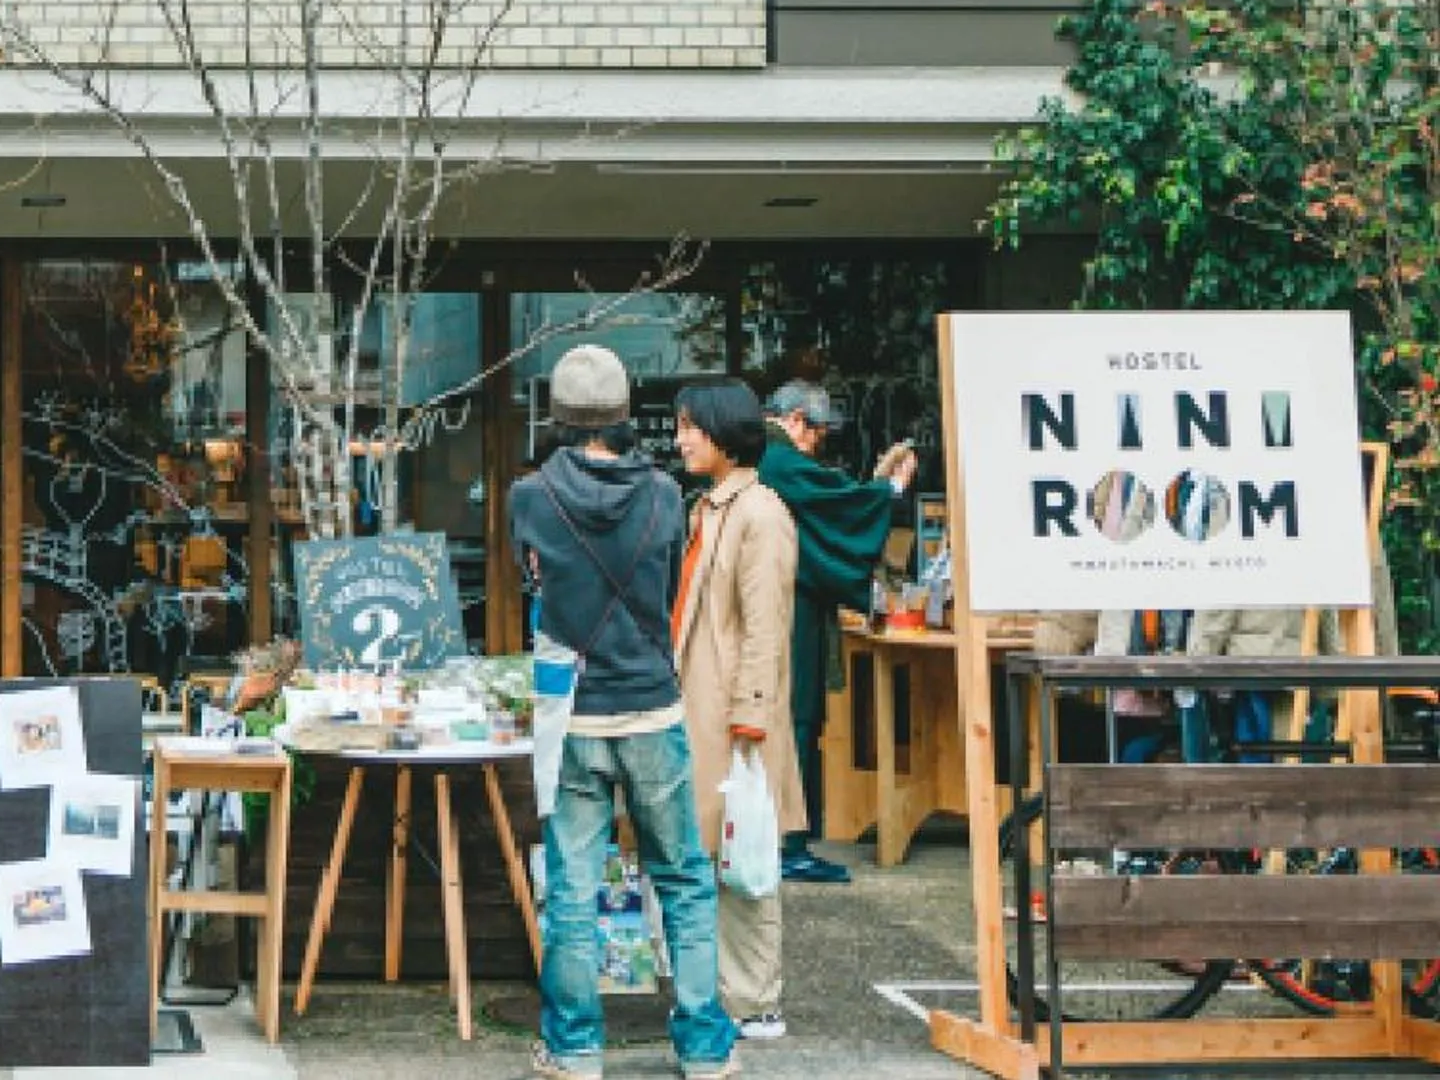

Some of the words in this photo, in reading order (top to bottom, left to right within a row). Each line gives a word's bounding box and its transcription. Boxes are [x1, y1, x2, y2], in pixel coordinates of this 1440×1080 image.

[1107, 351, 1203, 371] HOSTEL
[1021, 390, 1294, 451] NINI
[1030, 468, 1300, 543] ROOM
